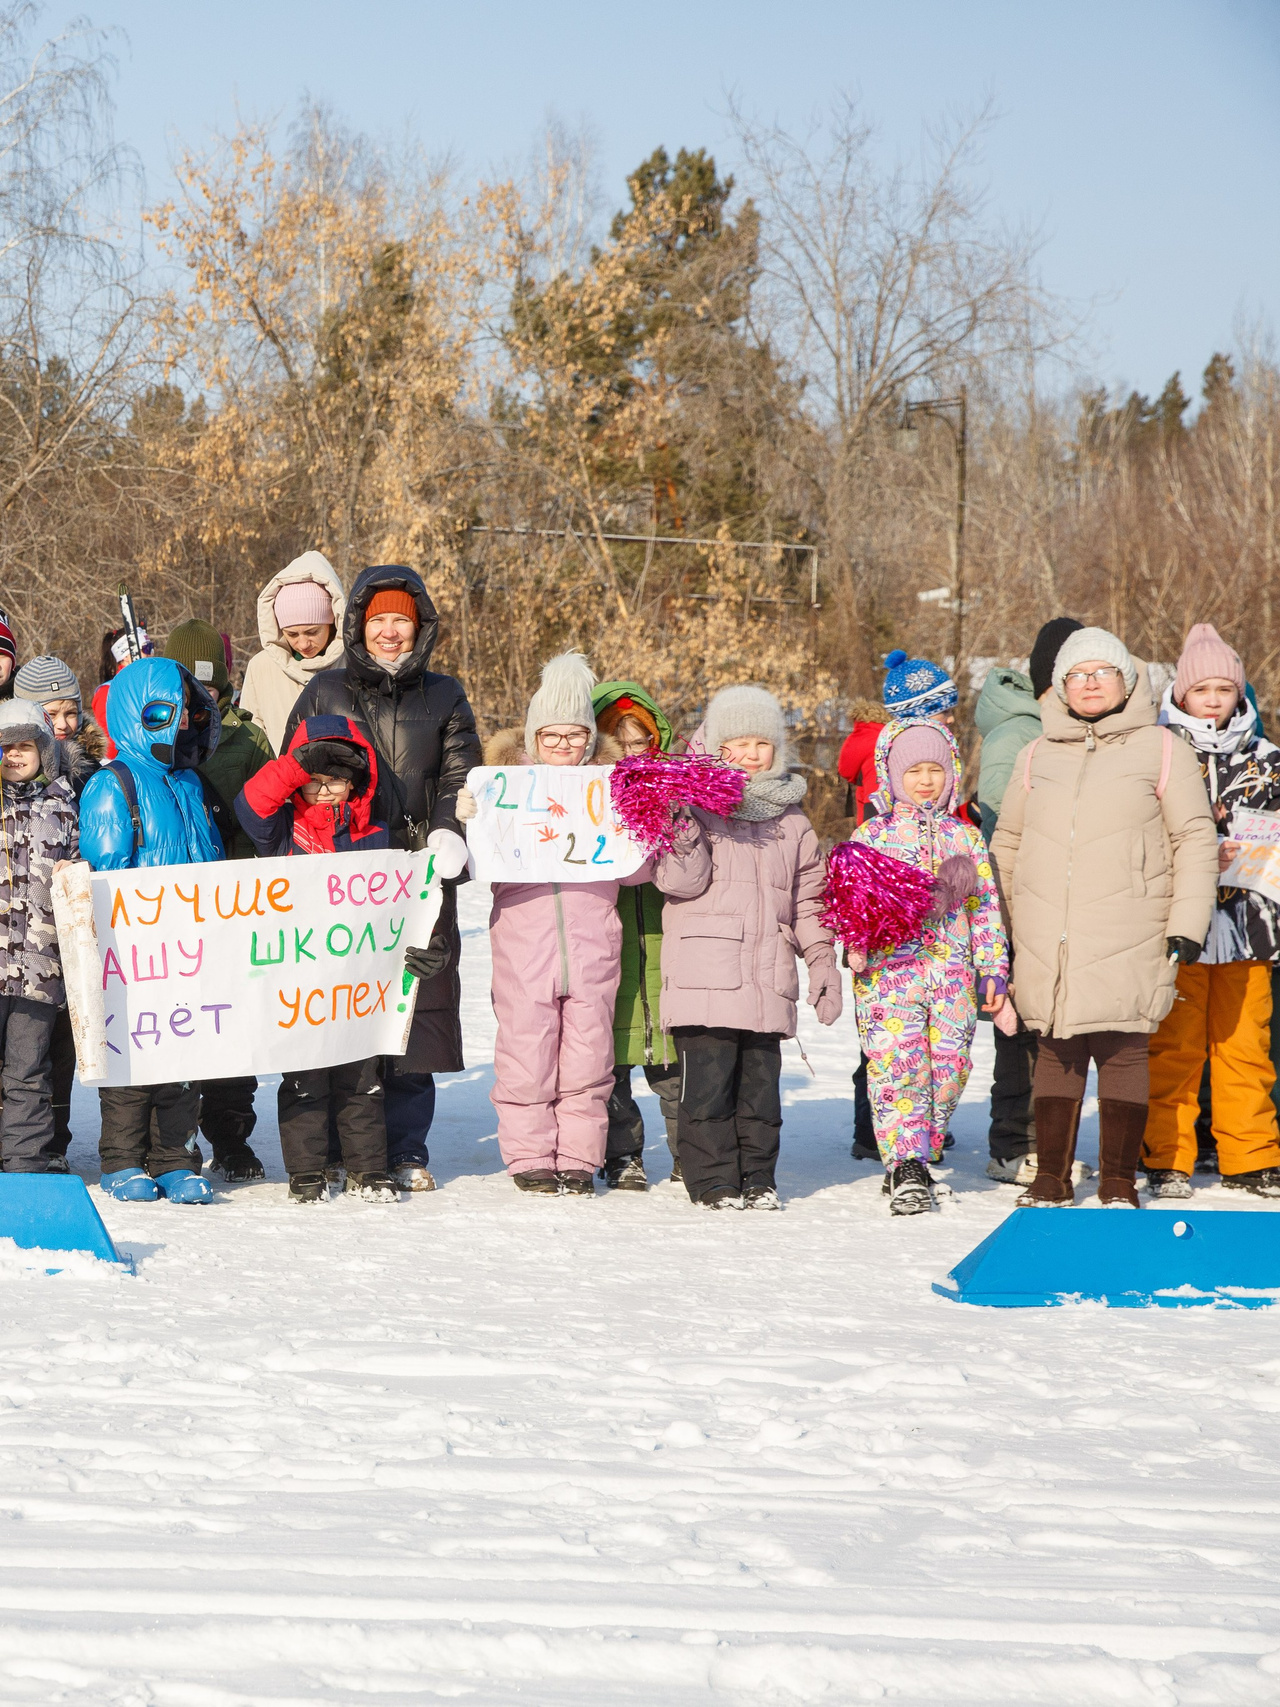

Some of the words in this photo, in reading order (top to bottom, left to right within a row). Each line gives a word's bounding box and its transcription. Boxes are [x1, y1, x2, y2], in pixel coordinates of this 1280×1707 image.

[563, 832, 614, 864] 22
[103, 938, 203, 990] АШУ
[250, 917, 406, 966] ШКОЛУ
[880, 974, 912, 995] BOOM
[873, 1012, 883, 1020] GO
[892, 1053, 922, 1077] BOOM
[883, 1093, 893, 1102] GO
